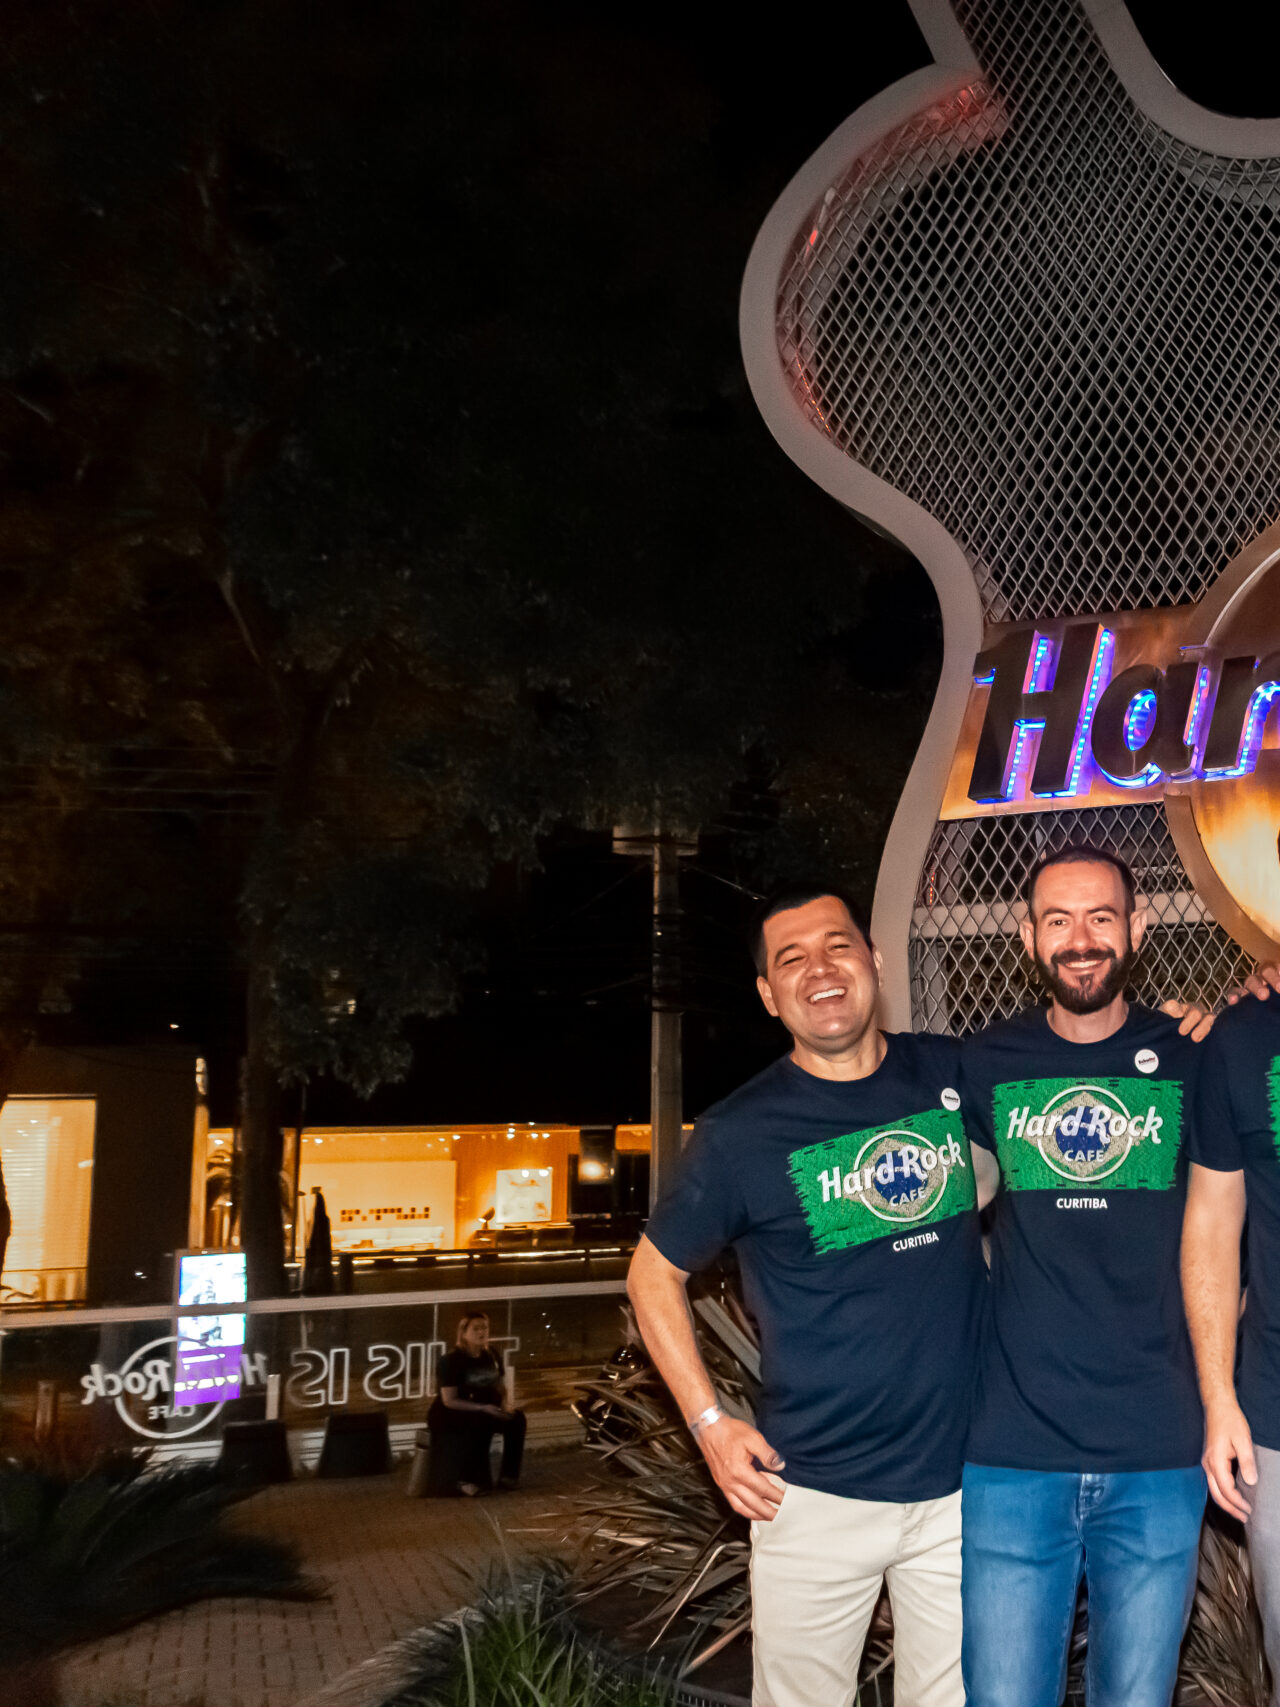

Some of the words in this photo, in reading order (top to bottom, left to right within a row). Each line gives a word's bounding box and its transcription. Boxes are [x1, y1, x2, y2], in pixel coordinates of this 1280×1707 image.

[1007, 1105, 1085, 1139] Hard
[1087, 1104, 1164, 1144] Rock
[1064, 1150, 1105, 1162] CAFE
[817, 1151, 896, 1202] Hard
[898, 1133, 965, 1181] Rock
[890, 1187, 927, 1207] CAFE
[1056, 1198, 1108, 1209] CURITIBA
[892, 1231, 939, 1251] CURITIBA
